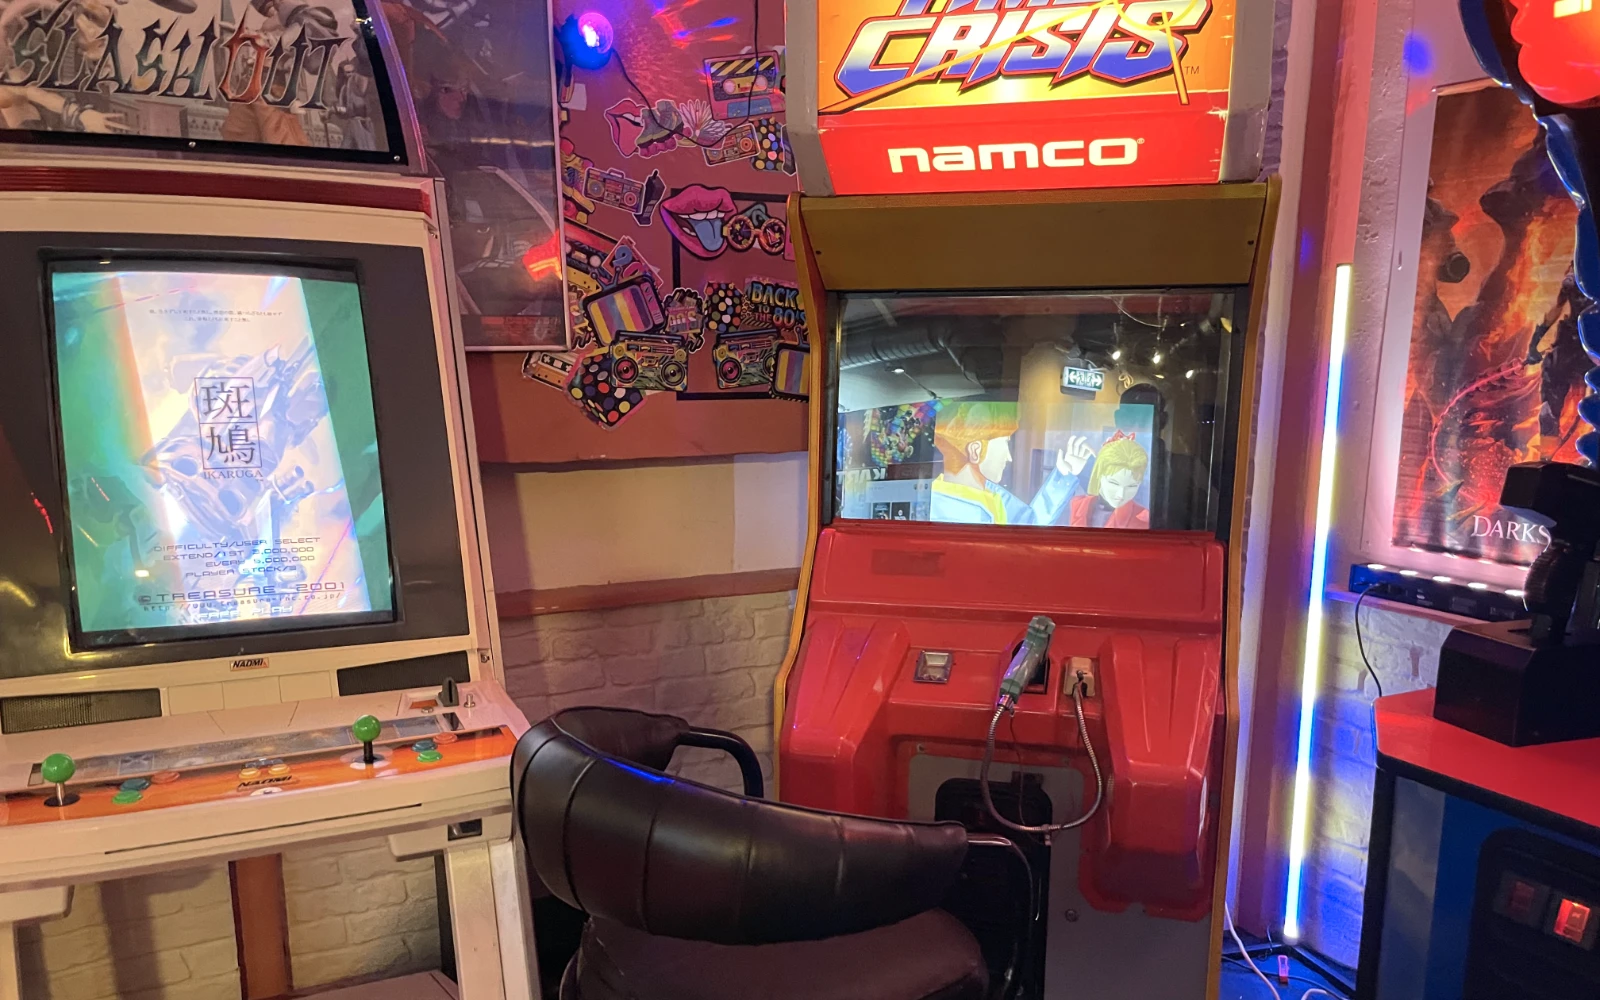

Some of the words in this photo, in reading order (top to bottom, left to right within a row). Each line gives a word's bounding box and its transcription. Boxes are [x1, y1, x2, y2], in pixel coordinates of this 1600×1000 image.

[834, 0, 1213, 98] CRISIS
[887, 138, 1138, 174] namco
[751, 281, 799, 310] BACK
[758, 304, 770, 314] TO
[201, 382, 256, 464] 斑鳩
[203, 469, 264, 480] IKARUGA
[274, 537, 321, 545] SELECT
[295, 581, 345, 592] 2001
